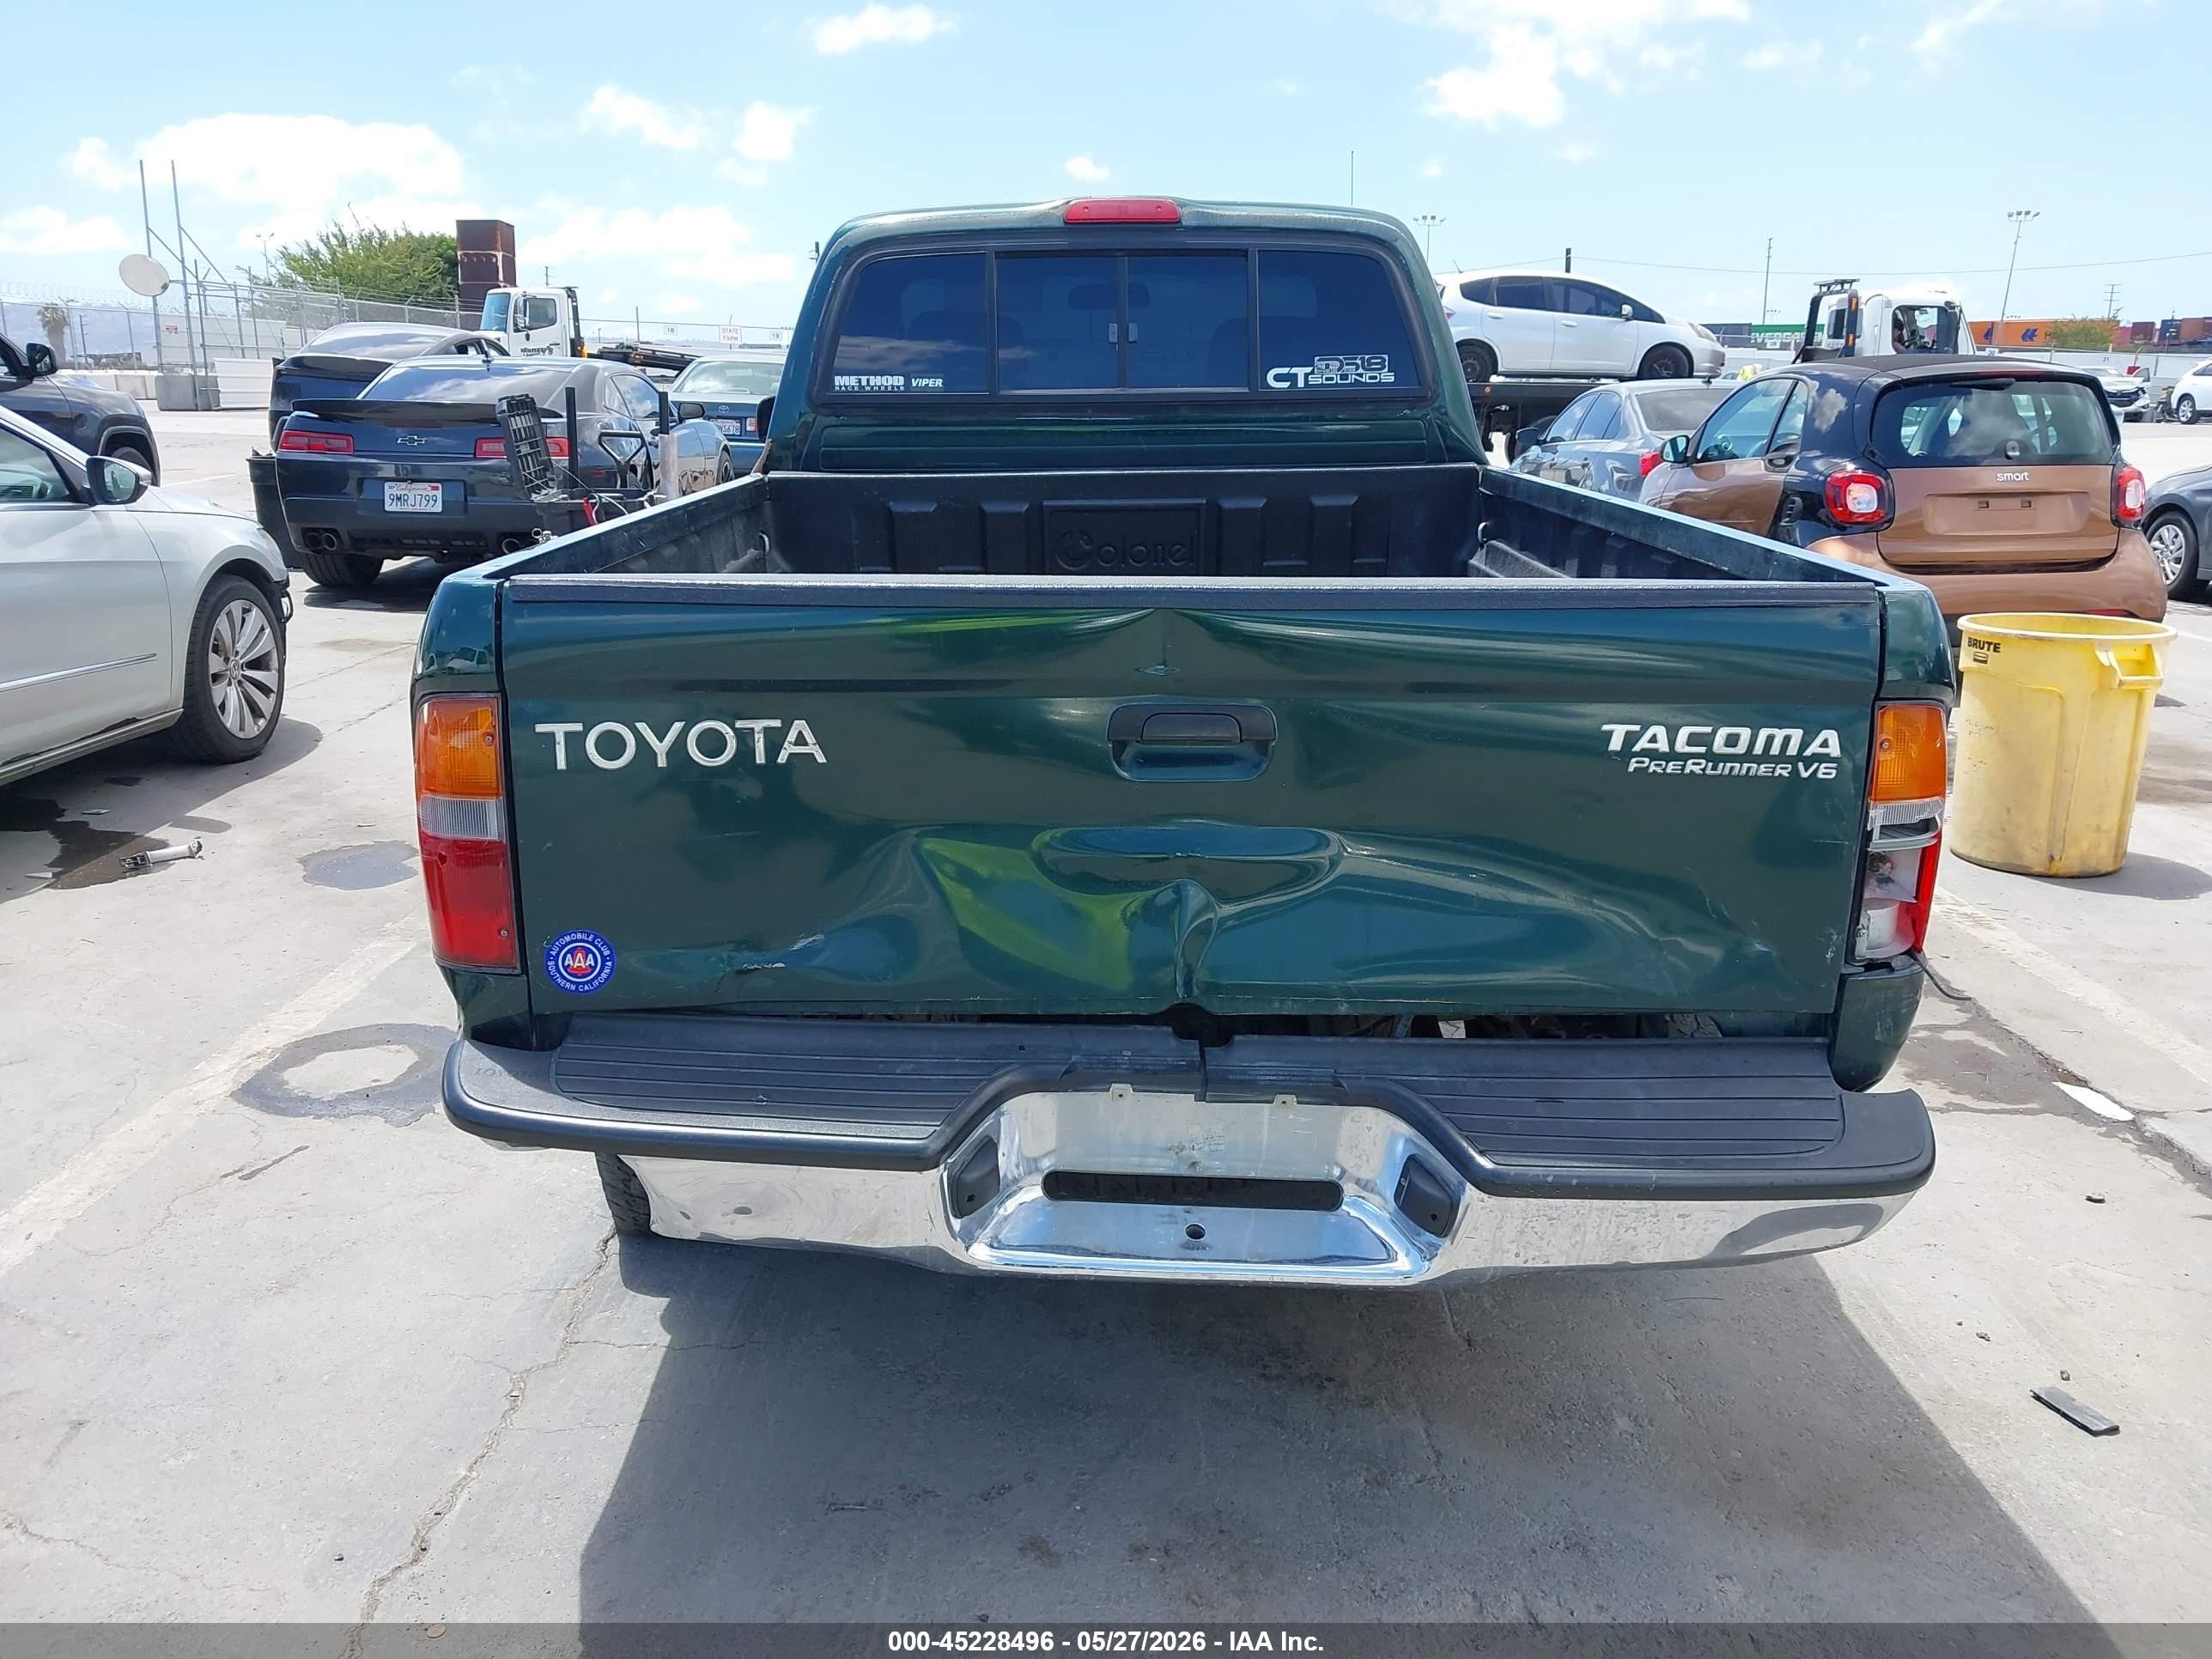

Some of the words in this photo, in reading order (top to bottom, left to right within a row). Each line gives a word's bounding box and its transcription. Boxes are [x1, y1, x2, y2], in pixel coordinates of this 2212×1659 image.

[834, 375, 904, 386] METHOD
[911, 378, 944, 387] VIPER
[1267, 368, 1313, 387] CT
[1308, 373, 1395, 385] SOUNDS
[1996, 471, 2029, 481] smart
[388, 493, 438, 508] 9MRJ799
[1057, 530, 1194, 571] Colonel
[1967, 637, 2001, 653] BRUTE
[535, 720, 827, 770] TOYOTA
[1601, 724, 1842, 757] TACOMA
[1798, 761, 1838, 779] V6
[550, 933, 595, 957] AUTOMOBILE
[594, 939, 611, 956] CLUB
[564, 952, 595, 969] AAA
[547, 960, 576, 991] SOUTHERN
[578, 961, 612, 992] CALIFORNIA
